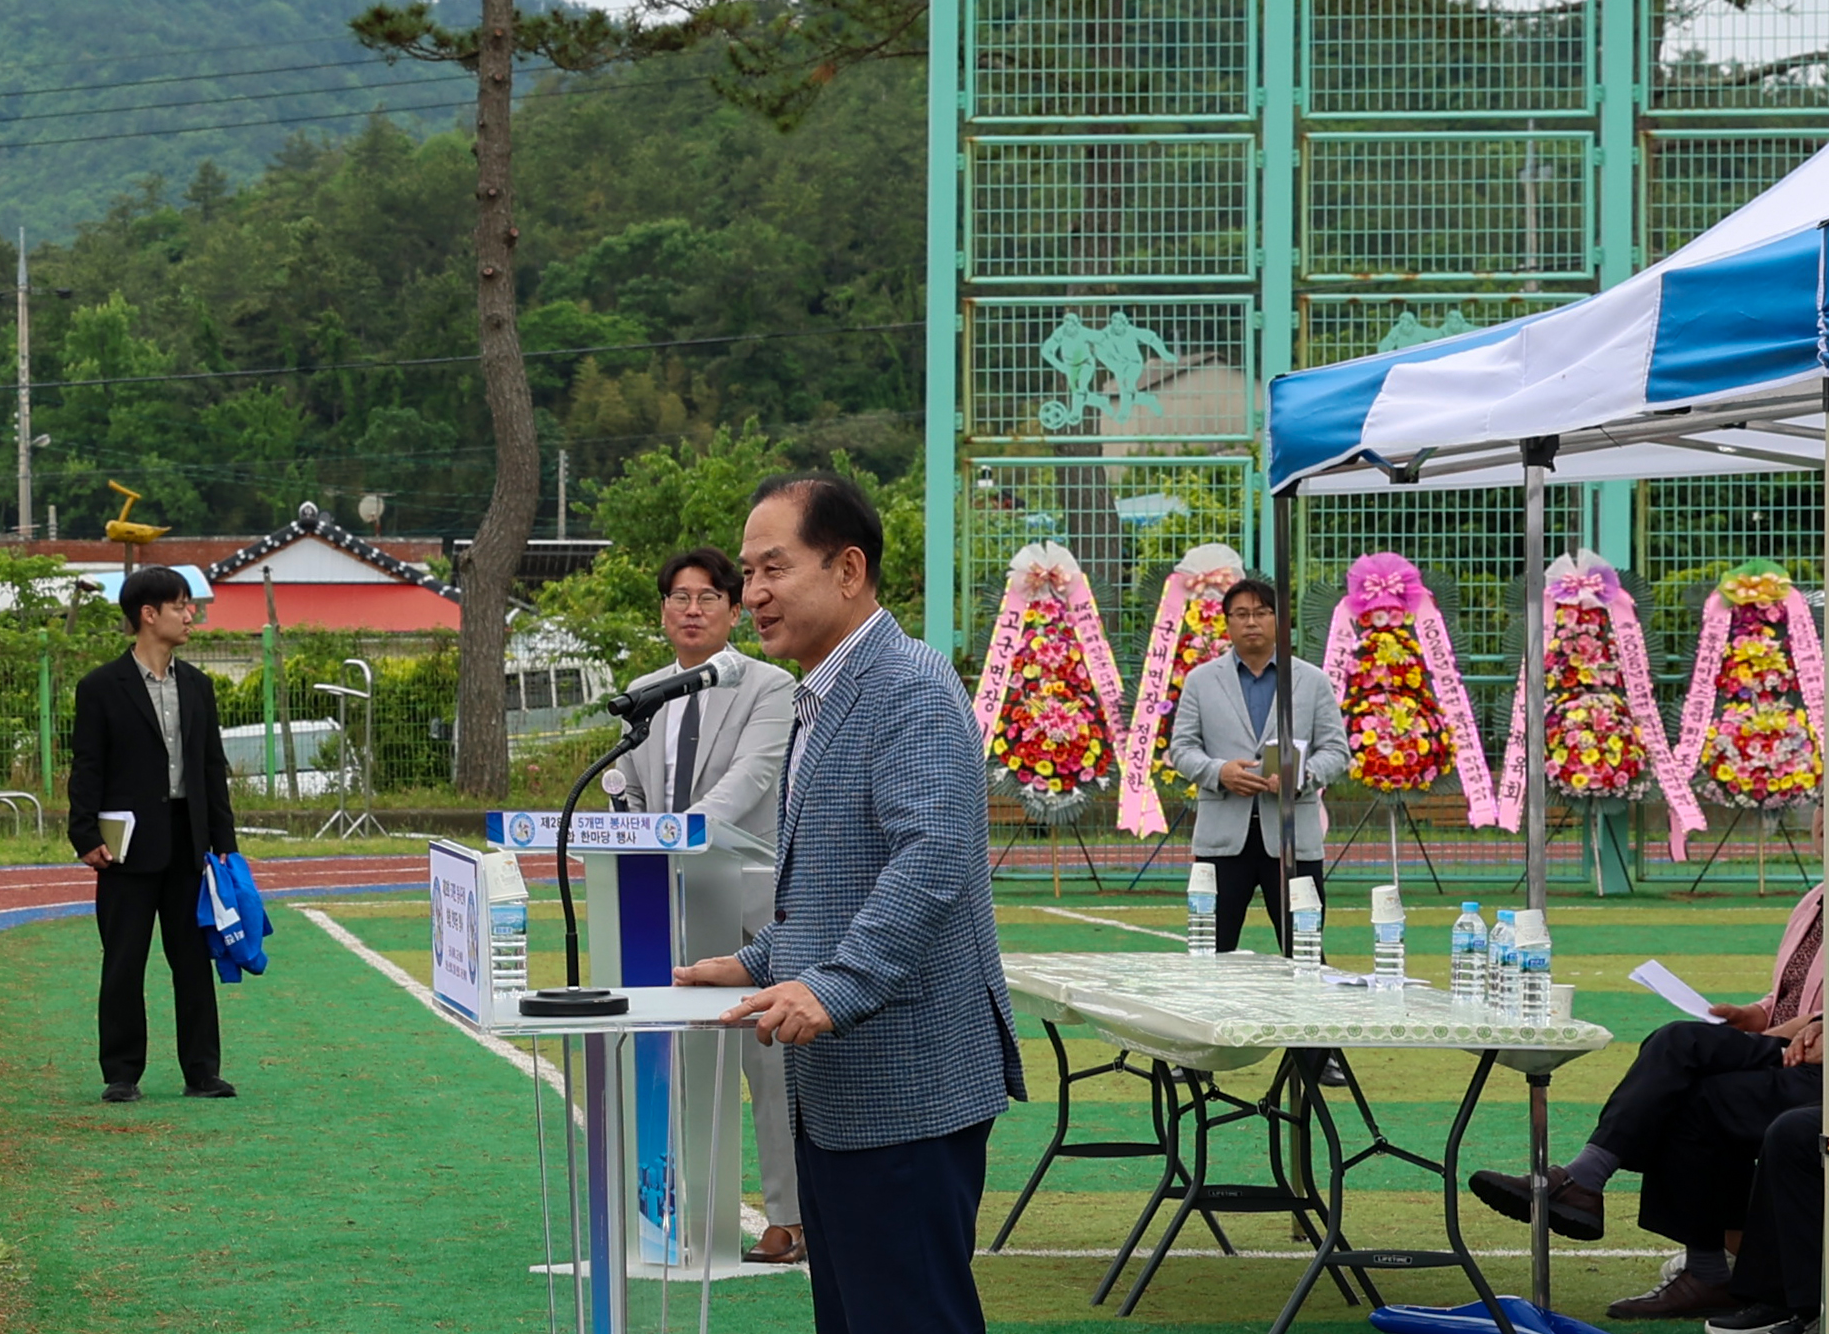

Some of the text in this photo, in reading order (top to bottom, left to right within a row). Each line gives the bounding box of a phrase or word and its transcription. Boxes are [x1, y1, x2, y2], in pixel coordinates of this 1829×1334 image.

[1422, 619, 1449, 671] 2025년
[1127, 620, 1175, 794] 군내면장 정진한
[577, 816, 605, 830] 5개면
[609, 816, 651, 830] 봉사단체
[580, 831, 611, 845] 한마당
[616, 831, 637, 845] 행사
